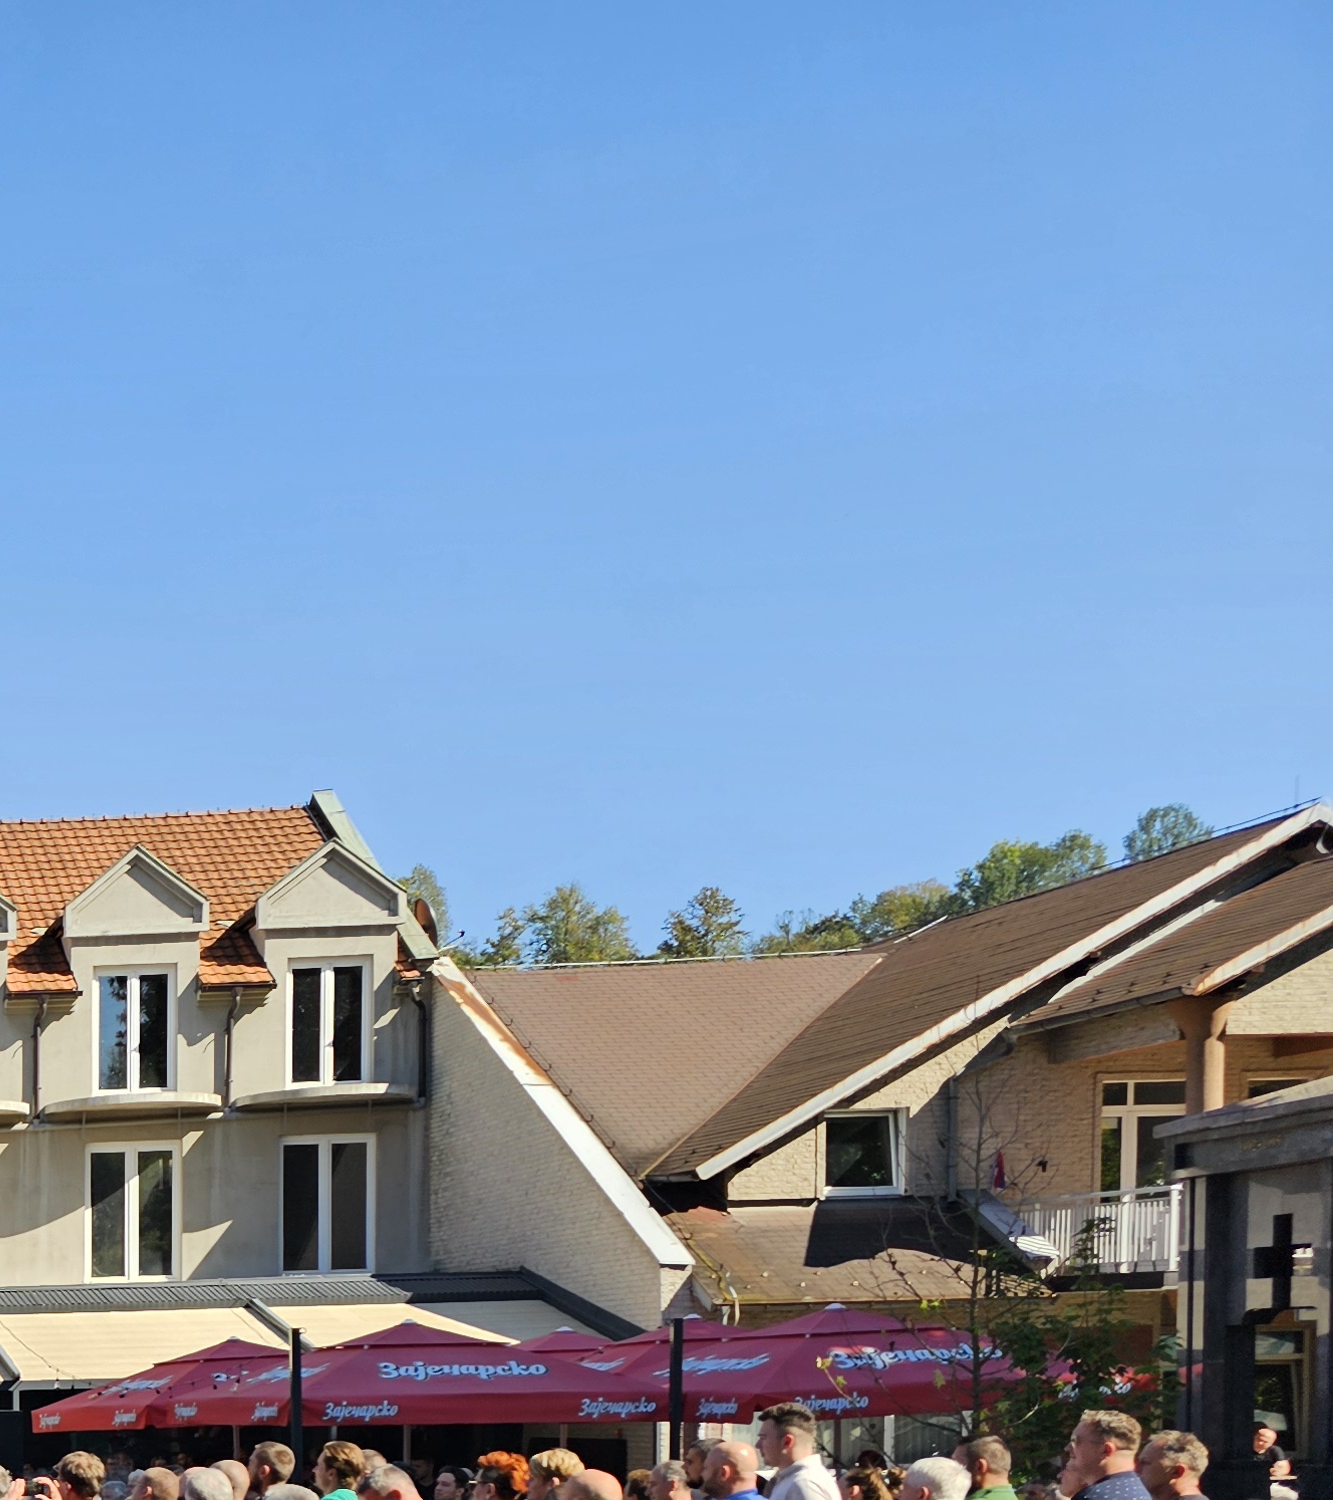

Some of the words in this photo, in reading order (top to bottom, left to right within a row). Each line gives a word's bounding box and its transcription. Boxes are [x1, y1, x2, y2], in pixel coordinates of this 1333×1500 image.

[377, 1360, 549, 1381] Зајечарско
[323, 1400, 398, 1422] Зајечарско
[578, 1396, 657, 1419] Зајечарско
